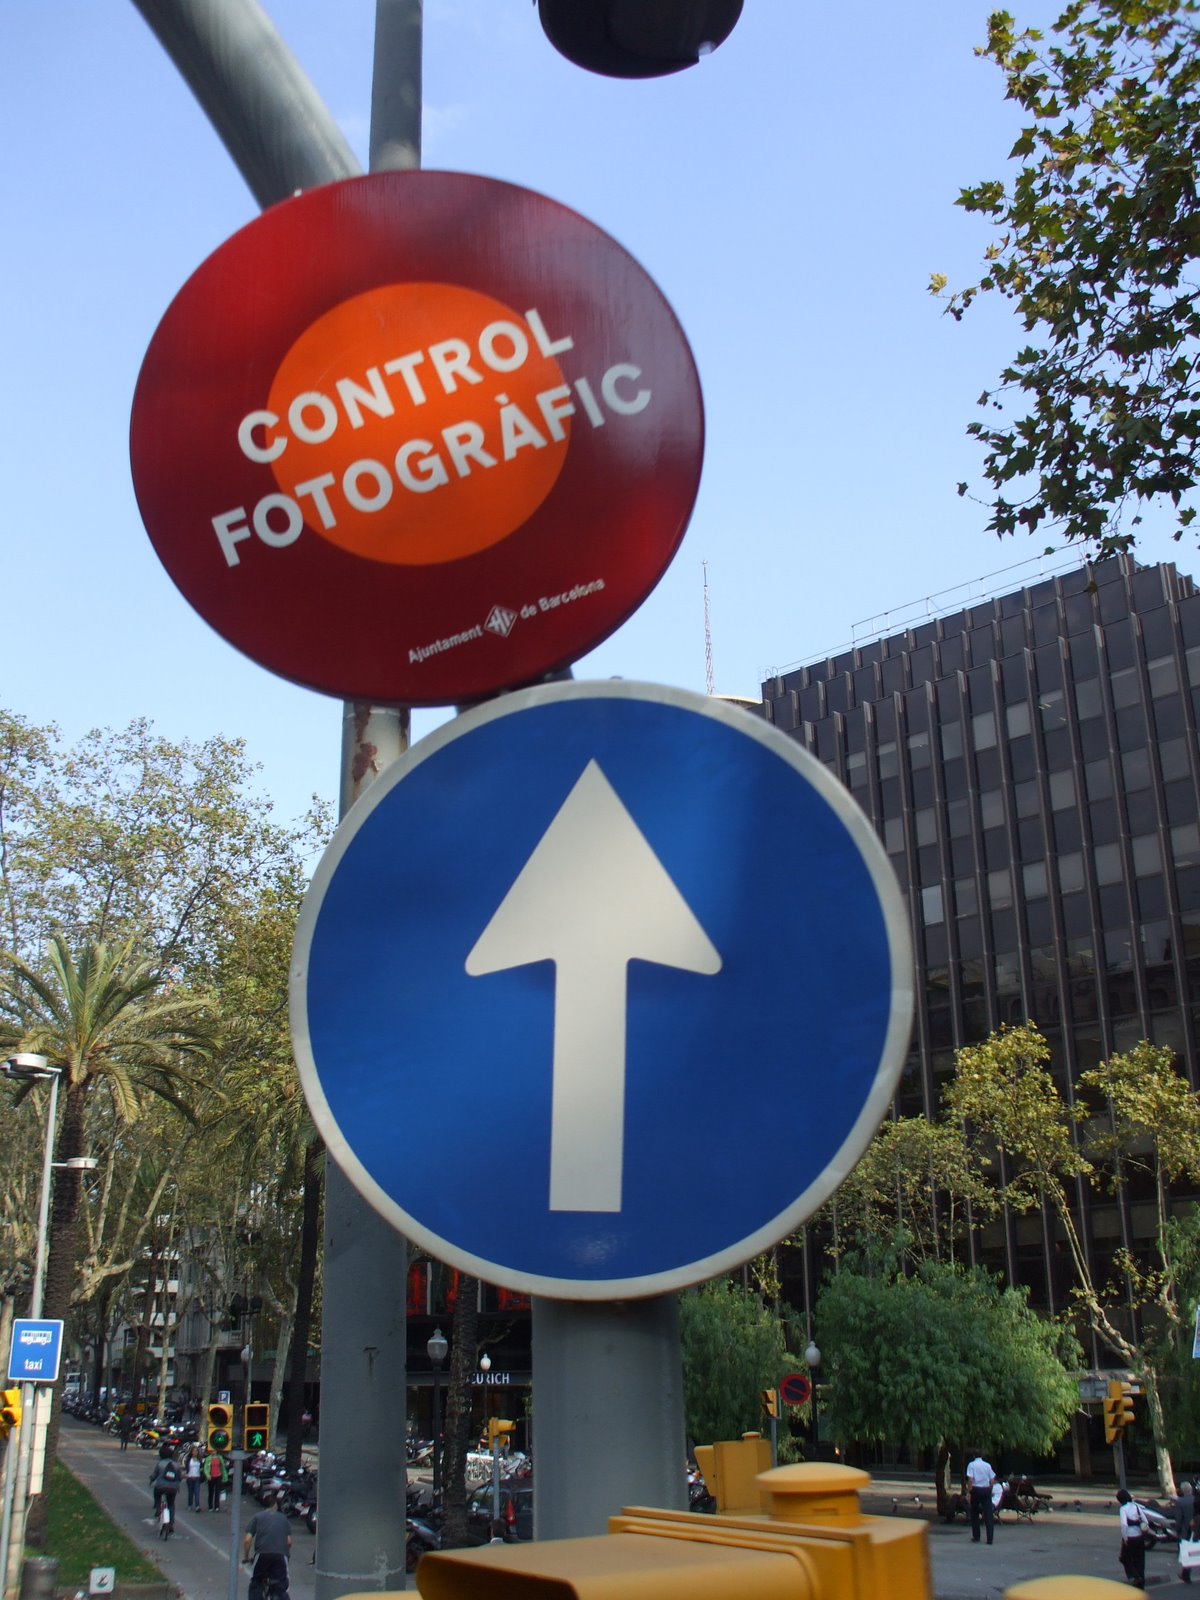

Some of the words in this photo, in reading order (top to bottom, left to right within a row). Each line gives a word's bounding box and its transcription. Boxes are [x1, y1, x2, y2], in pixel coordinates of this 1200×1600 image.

[238, 309, 574, 464] CONTROL
[211, 363, 652, 567] FOTOGRÀFIC
[408, 624, 484, 663] Ajuntament
[520, 604, 537, 619] de
[539, 578, 605, 611] Barcelona
[24, 1358, 43, 1370] taxi
